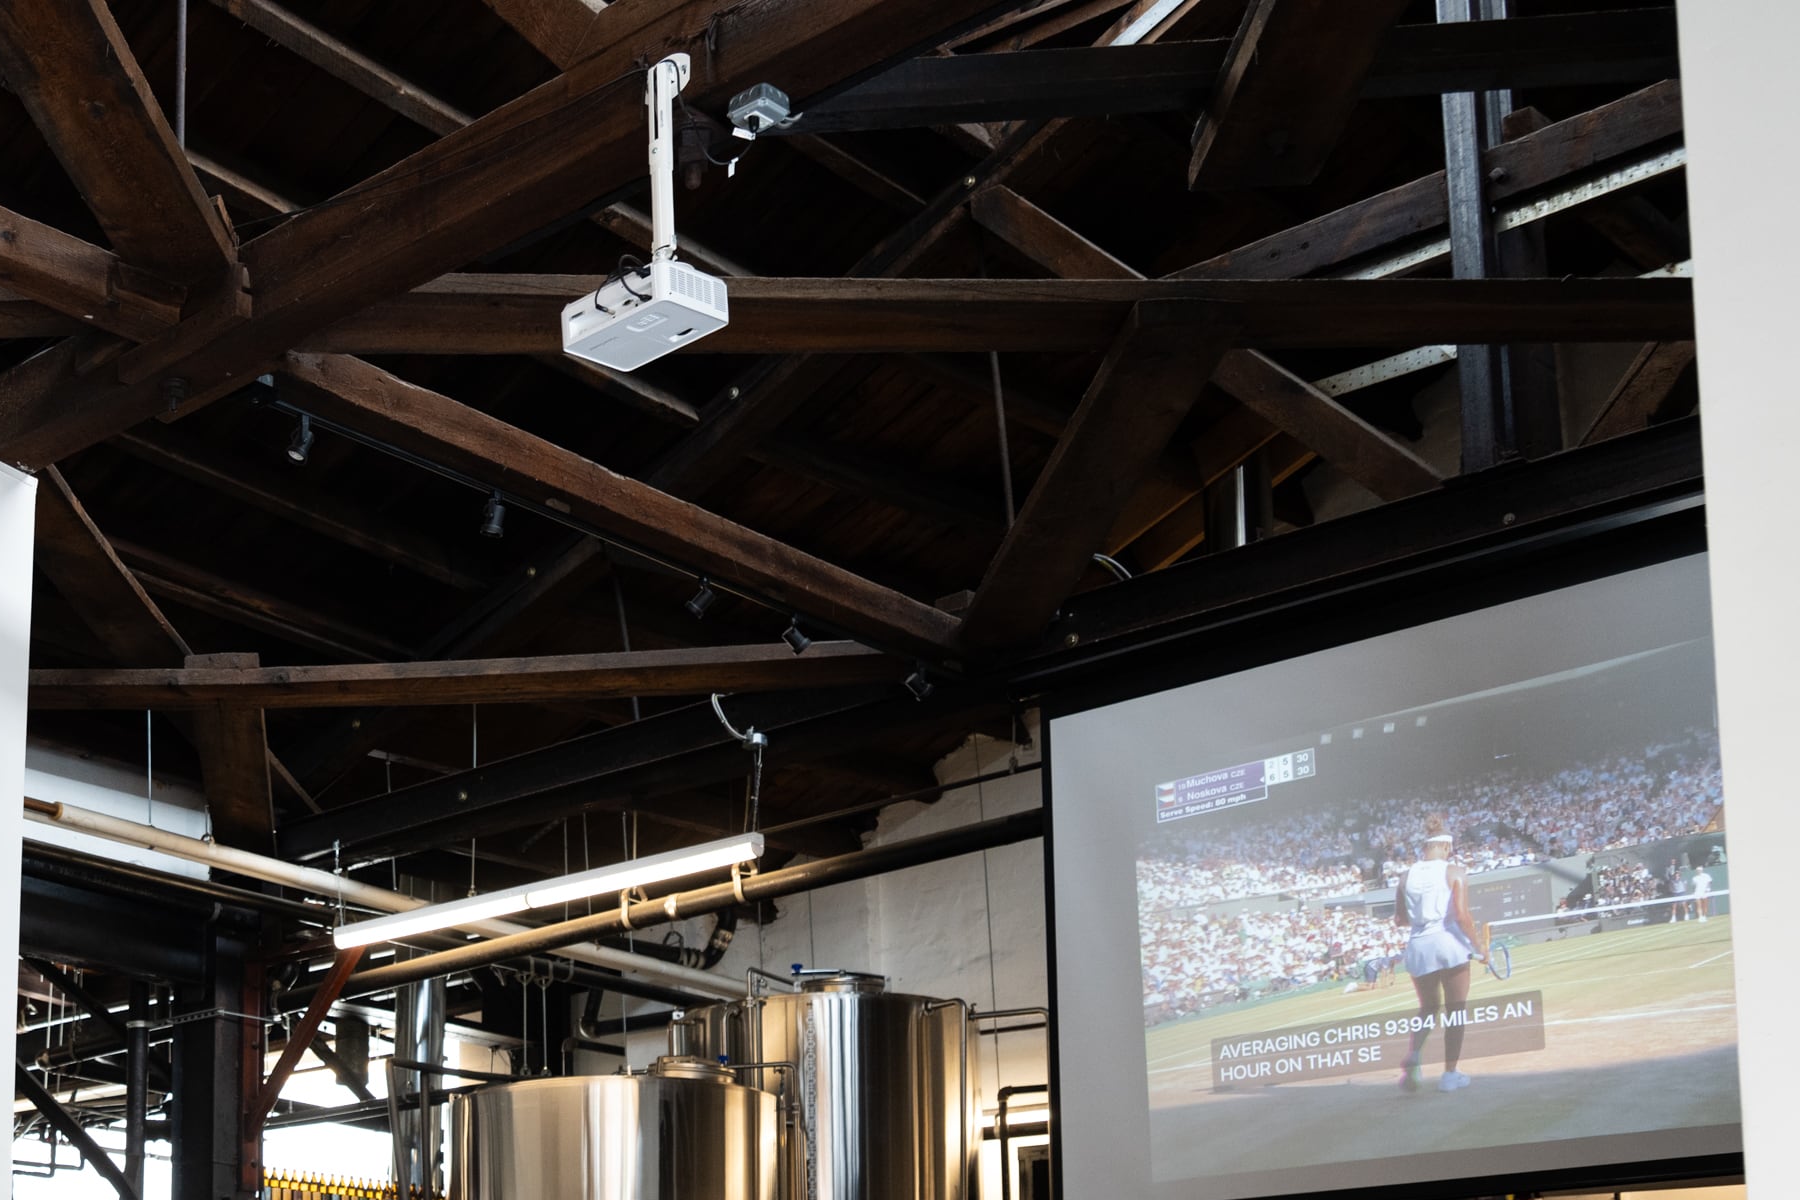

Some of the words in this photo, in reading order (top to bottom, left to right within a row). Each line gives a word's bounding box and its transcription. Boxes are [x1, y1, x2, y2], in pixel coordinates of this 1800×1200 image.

[1186, 770, 1228, 790] Muchova
[1296, 752, 1309, 763] 30
[1187, 785, 1228, 800] Noskova
[1297, 765, 1310, 776] 30
[1159, 807, 1183, 819] Serve
[1185, 801, 1214, 813] Speed:
[1227, 793, 1246, 804] mph
[1219, 1031, 1320, 1060] AVERAGING
[1323, 1022, 1381, 1046] CHRIS
[1384, 1014, 1436, 1036] 9394
[1439, 1005, 1499, 1029] MILES
[1503, 1000, 1533, 1019] AN
[1220, 1062, 1272, 1082] HOUR
[1275, 1056, 1303, 1075] ON
[1306, 1049, 1352, 1069] THAT
[1357, 1045, 1382, 1063] SE
